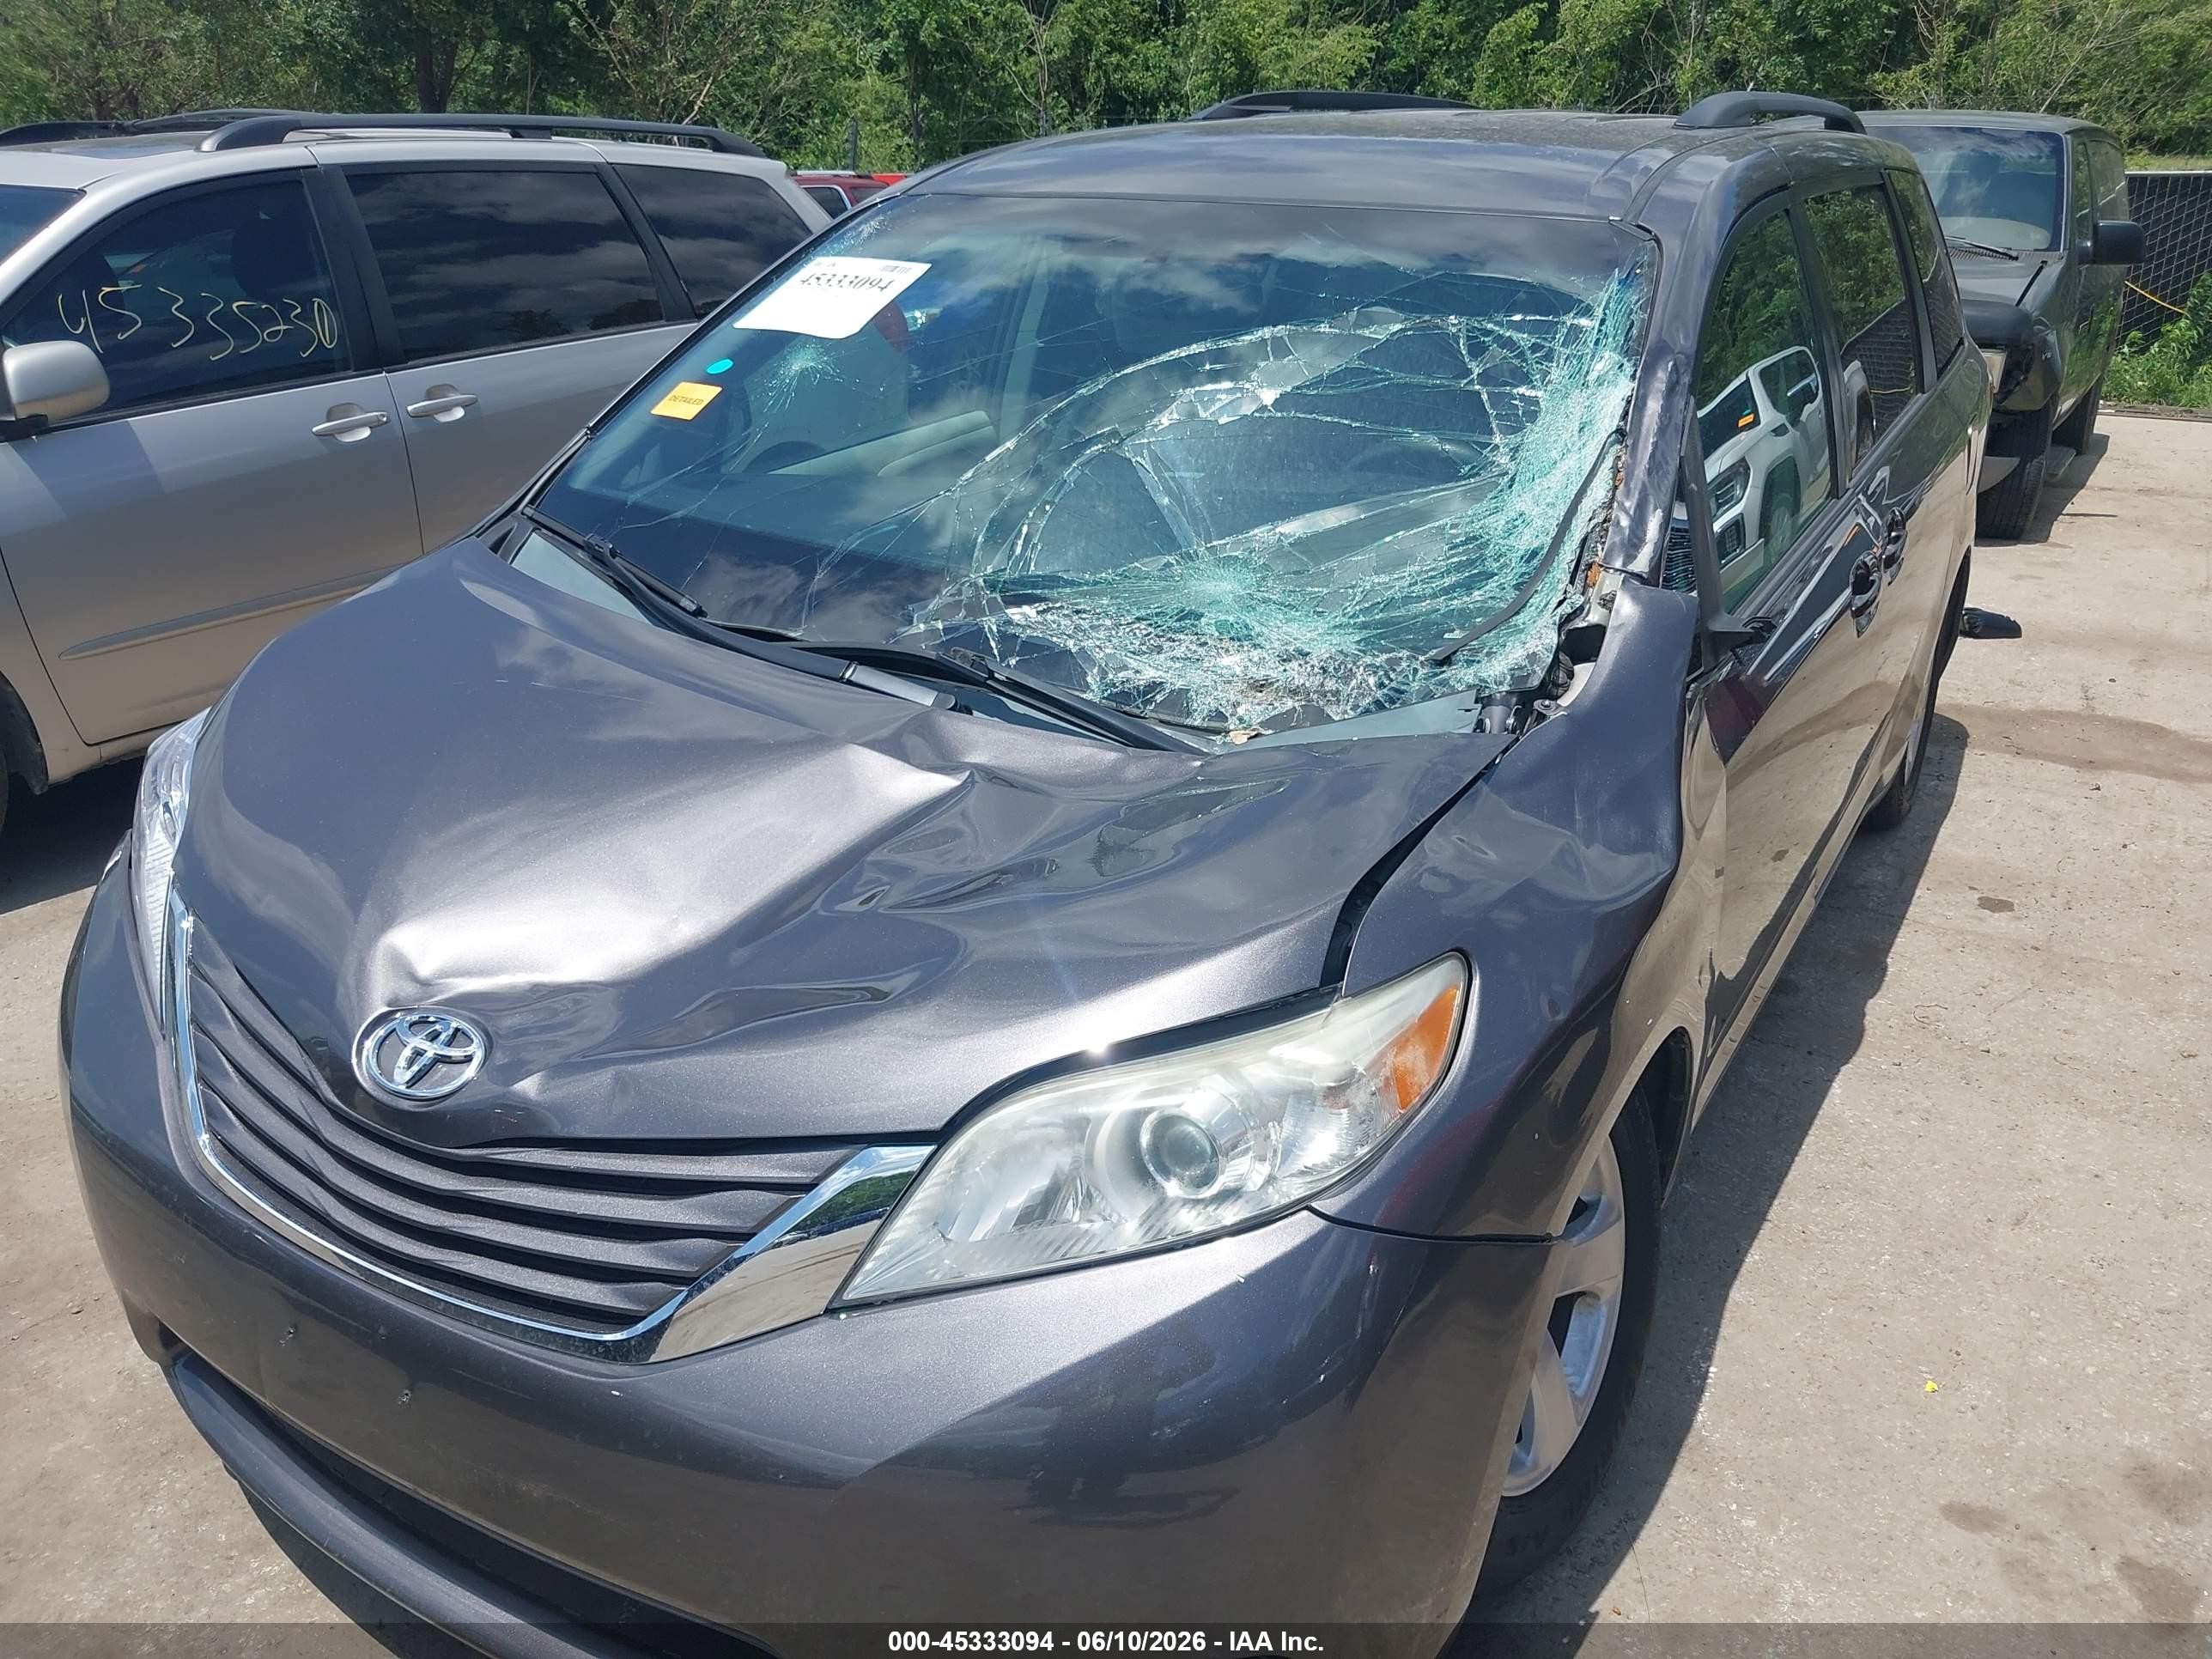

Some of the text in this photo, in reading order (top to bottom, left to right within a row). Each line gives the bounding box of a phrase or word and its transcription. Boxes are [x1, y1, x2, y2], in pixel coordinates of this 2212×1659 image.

[799, 273, 895, 292] 45333094
[58, 283, 338, 361] 45335230
[668, 395, 704, 405] DETAILED
